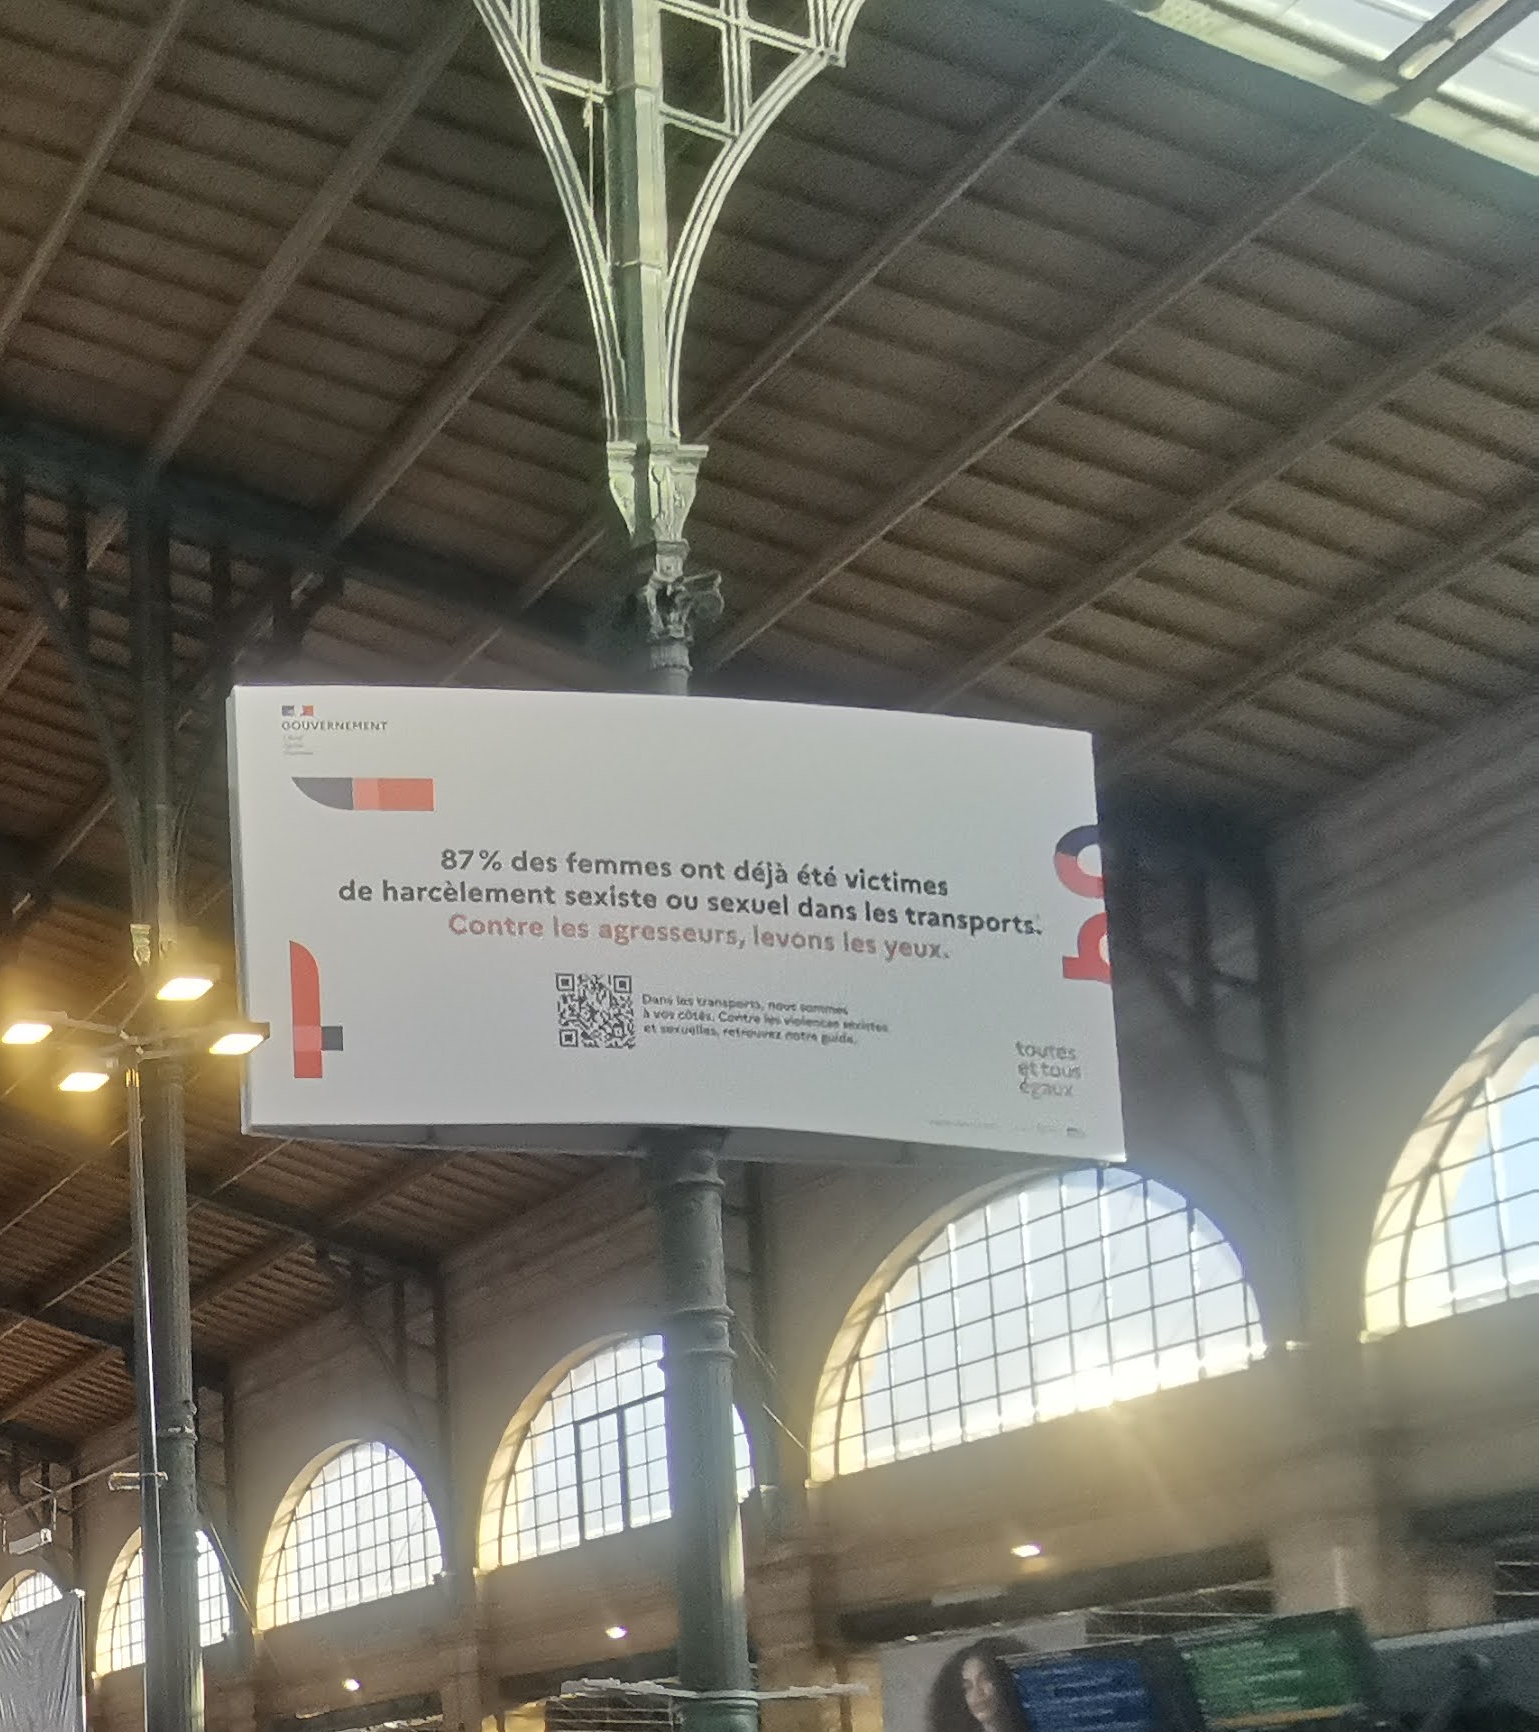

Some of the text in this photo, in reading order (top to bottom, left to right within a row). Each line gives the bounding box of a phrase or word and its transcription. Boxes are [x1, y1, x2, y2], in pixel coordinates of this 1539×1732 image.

[281, 720, 388, 731] GOUVERNEMENT
[511, 850, 558, 873] des
[566, 851, 672, 878] femmes
[680, 861, 725, 880] ont
[734, 860, 788, 889] déjà
[797, 863, 838, 888] été
[845, 868, 948, 897] victimes
[338, 879, 1043, 937] de harcèlement sexiste ou sexuel dans les transports.
[448, 913, 949, 963] Contre les agresseurs, levons les yeux.
[1015, 1041, 1076, 1060] toutes
